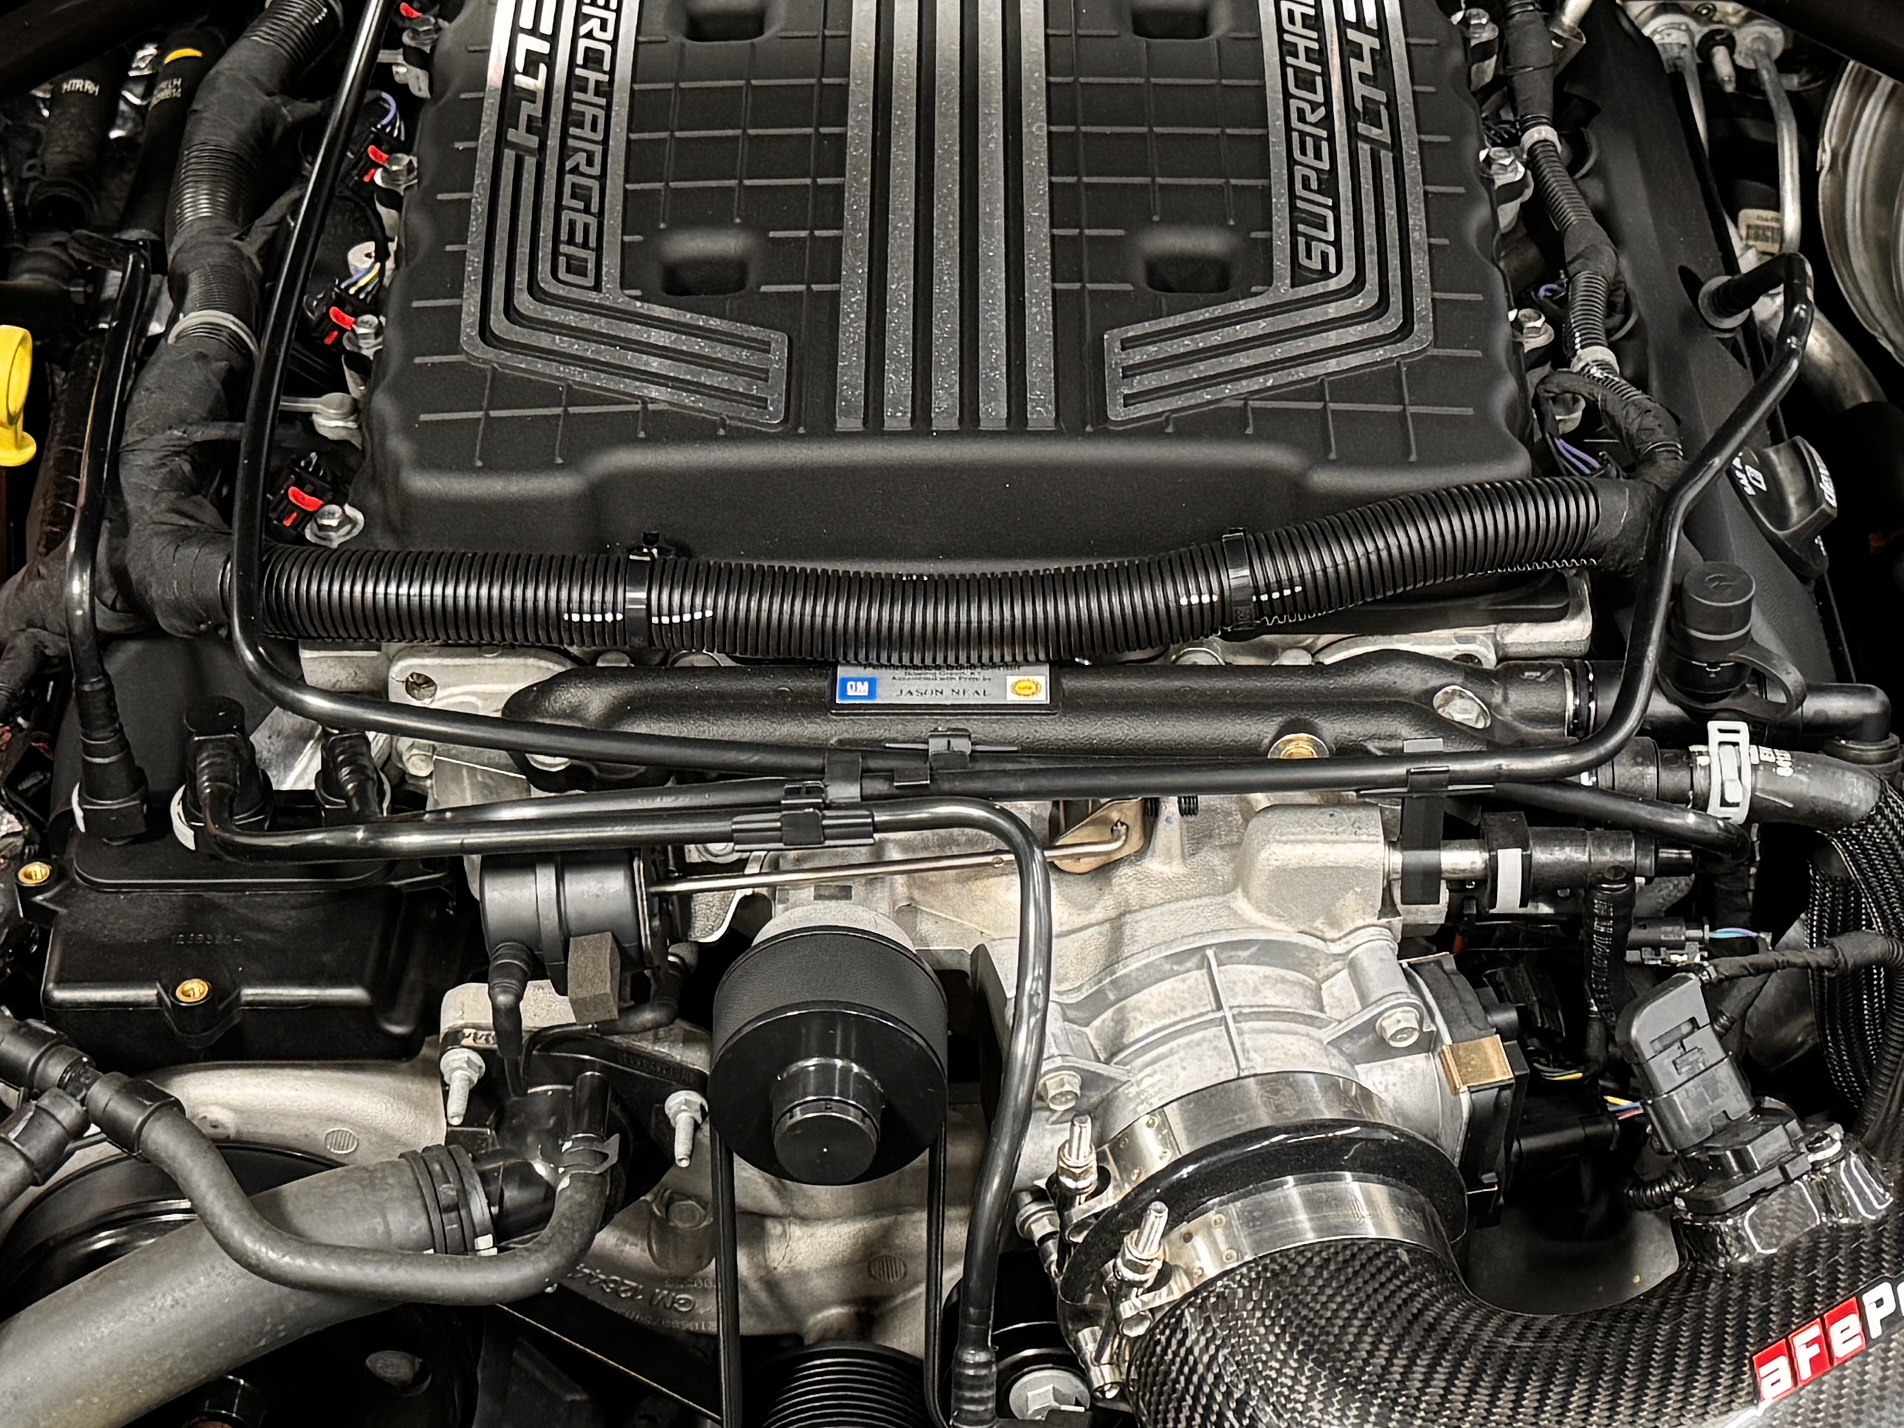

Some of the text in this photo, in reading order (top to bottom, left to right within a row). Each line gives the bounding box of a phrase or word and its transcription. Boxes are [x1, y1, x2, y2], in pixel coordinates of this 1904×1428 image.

[506, 32, 551, 149] LT4
[1346, 27, 1392, 151] LT4
[897, 688, 992, 698] JASON NEAL
